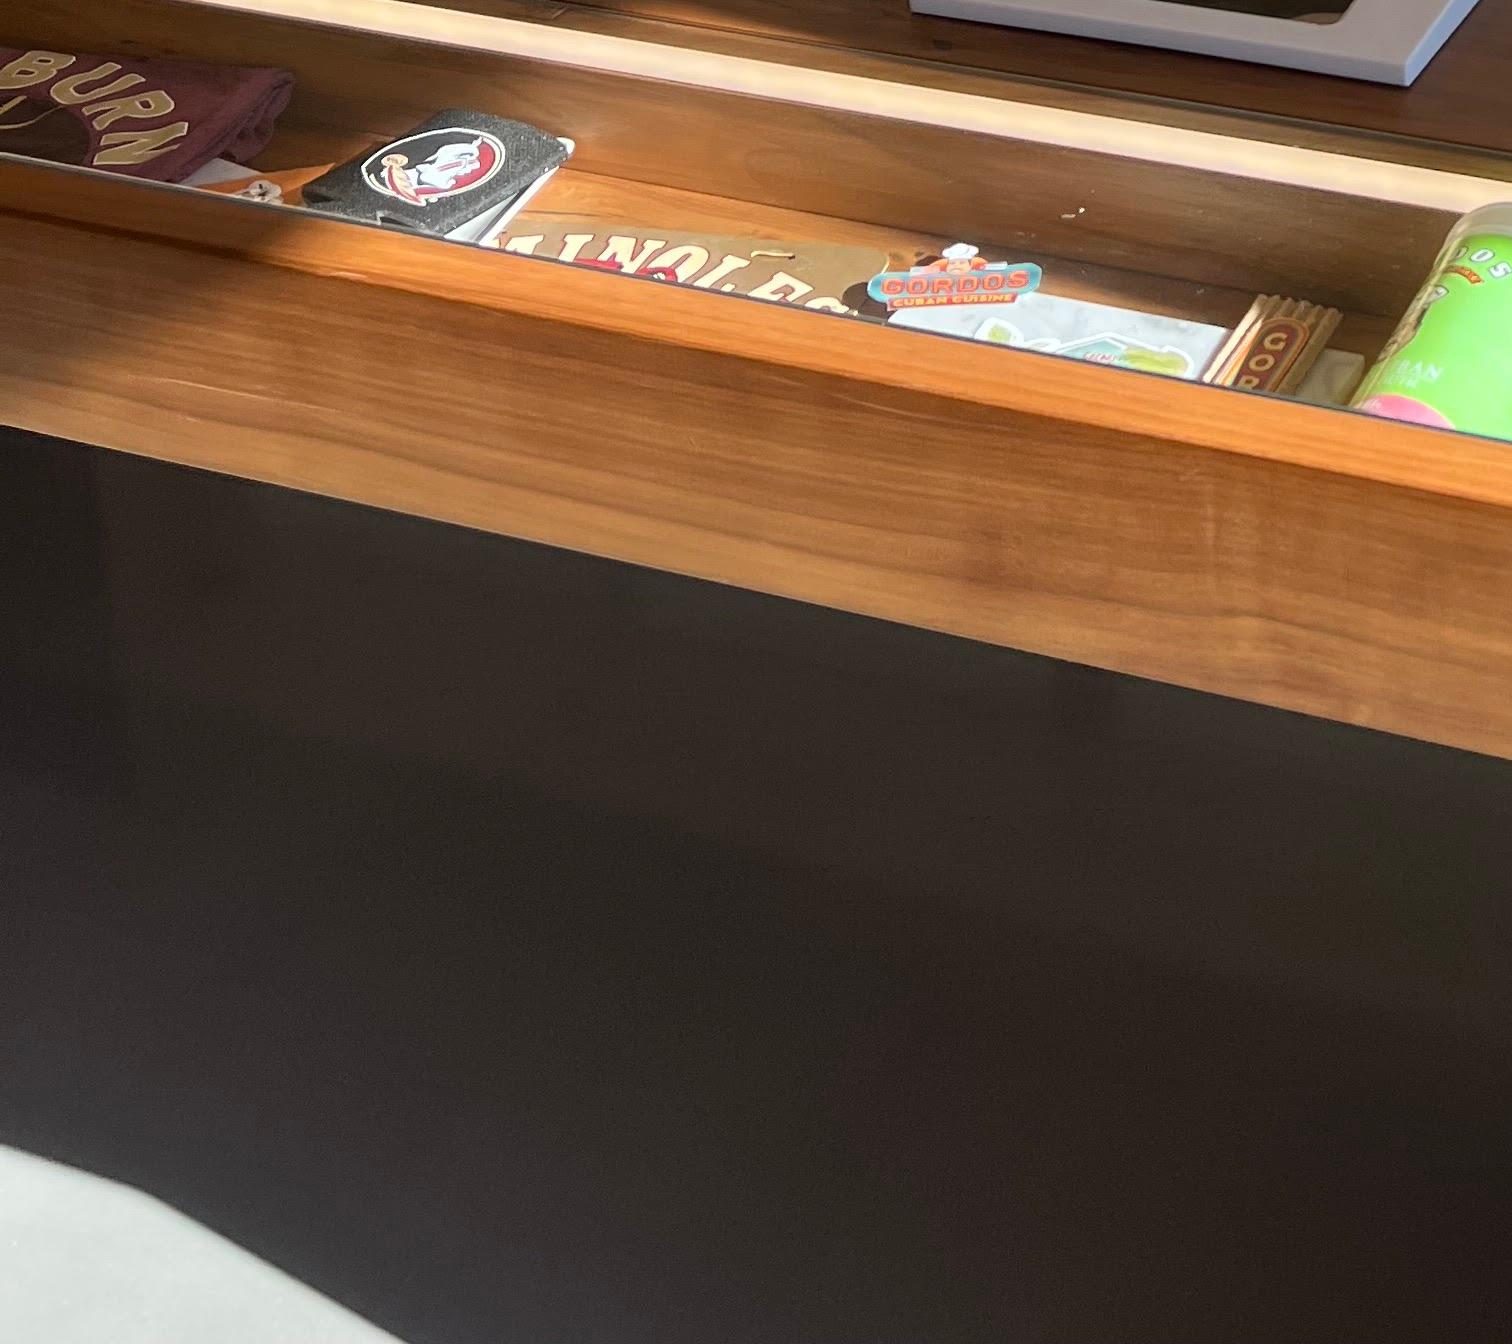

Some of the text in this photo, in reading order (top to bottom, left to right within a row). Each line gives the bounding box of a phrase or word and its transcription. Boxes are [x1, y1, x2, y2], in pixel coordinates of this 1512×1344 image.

[0, 50, 188, 165] BURN
[881, 270, 1030, 296] GORDOS
[892, 293, 1013, 308] CUBAN CUISINE
